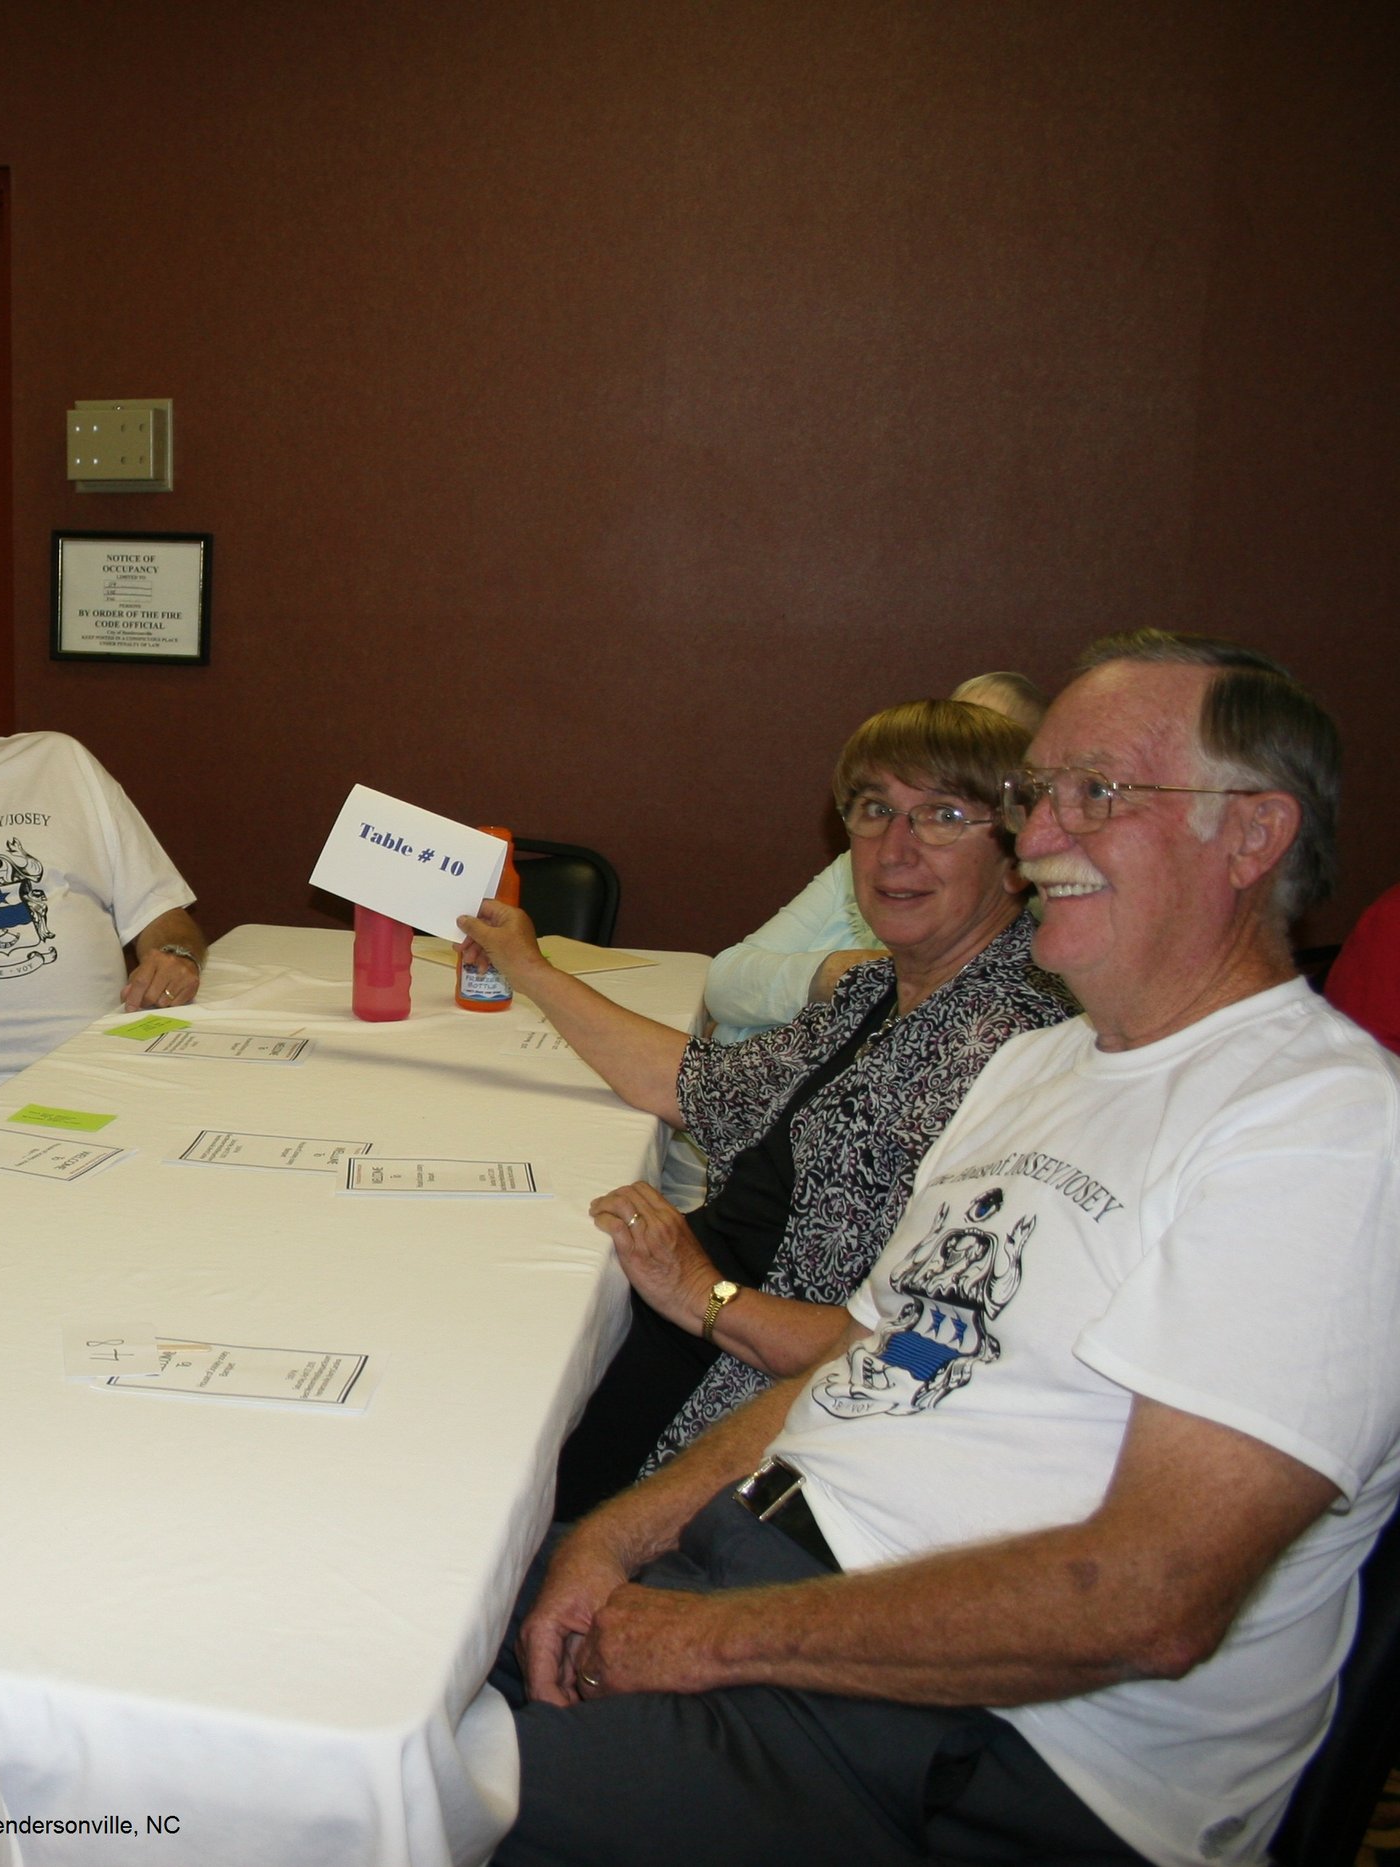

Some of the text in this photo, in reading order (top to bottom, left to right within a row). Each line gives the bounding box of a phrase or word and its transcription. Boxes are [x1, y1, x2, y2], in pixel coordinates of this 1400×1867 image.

[106, 554, 156, 563] NOTICE OF
[102, 565, 158, 573] OCCUPANCY
[79, 609, 182, 620] BY ORDER OF THE FIRE
[94, 620, 165, 629] CODE OFFICIAL
[358, 822, 465, 877] Table # 10
[16, 963, 33, 973] VOY
